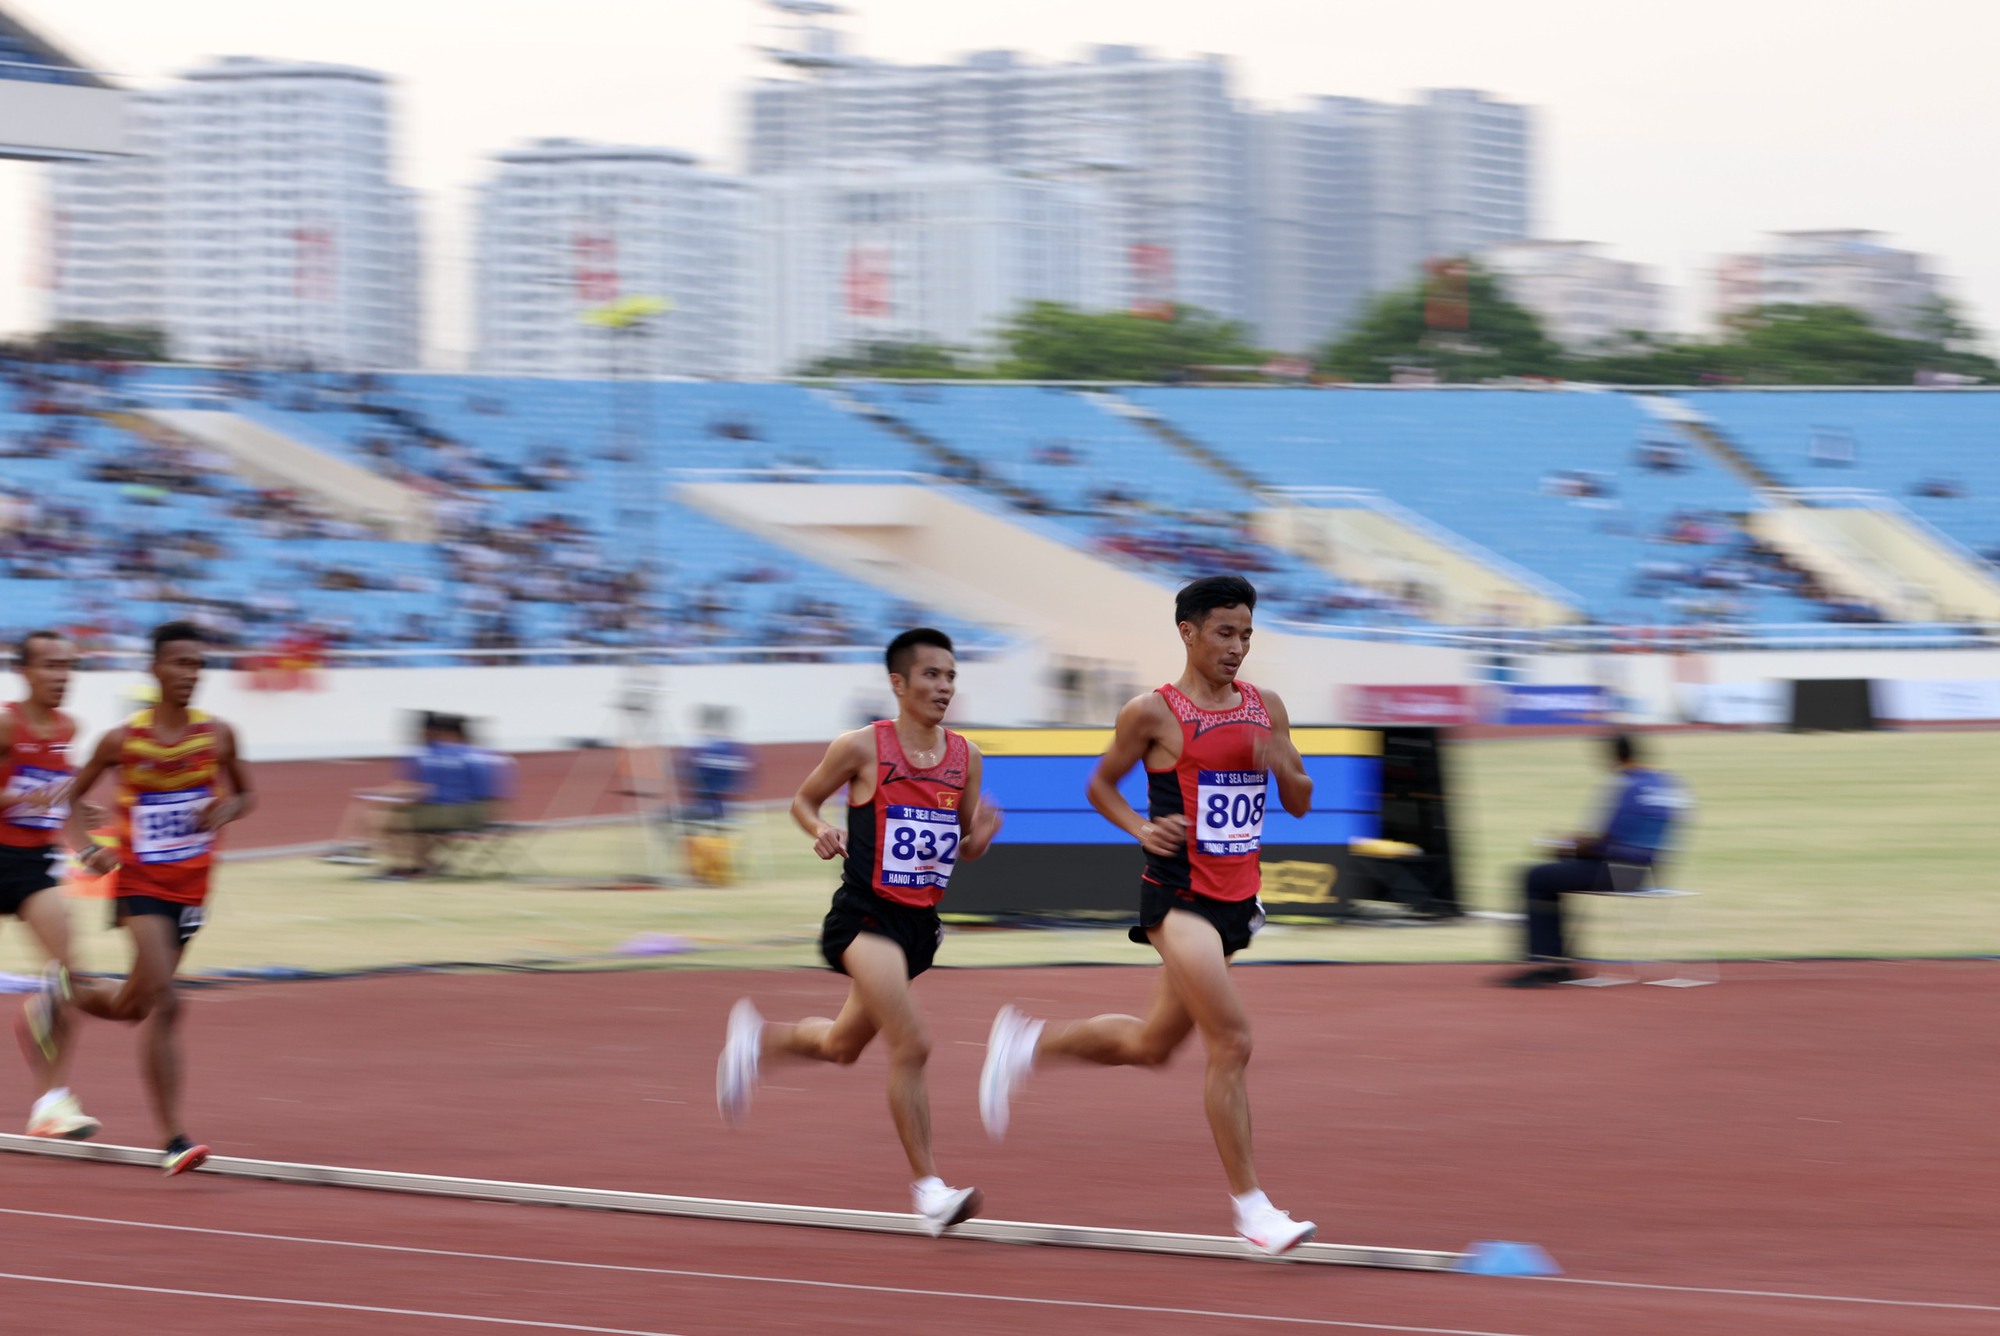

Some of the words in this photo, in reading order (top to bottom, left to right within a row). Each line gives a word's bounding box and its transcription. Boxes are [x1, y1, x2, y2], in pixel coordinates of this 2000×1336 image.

[1229, 773, 1243, 784] SEA
[1243, 773, 1264, 784] Games
[916, 809, 930, 821] SEA
[930, 811, 957, 823] Games
[1206, 793, 1265, 829] 808
[892, 827, 958, 864] 832
[1204, 842, 1225, 854] HANOI
[1229, 842, 1250, 853] VIETN
[888, 873, 910, 885] HANOI
